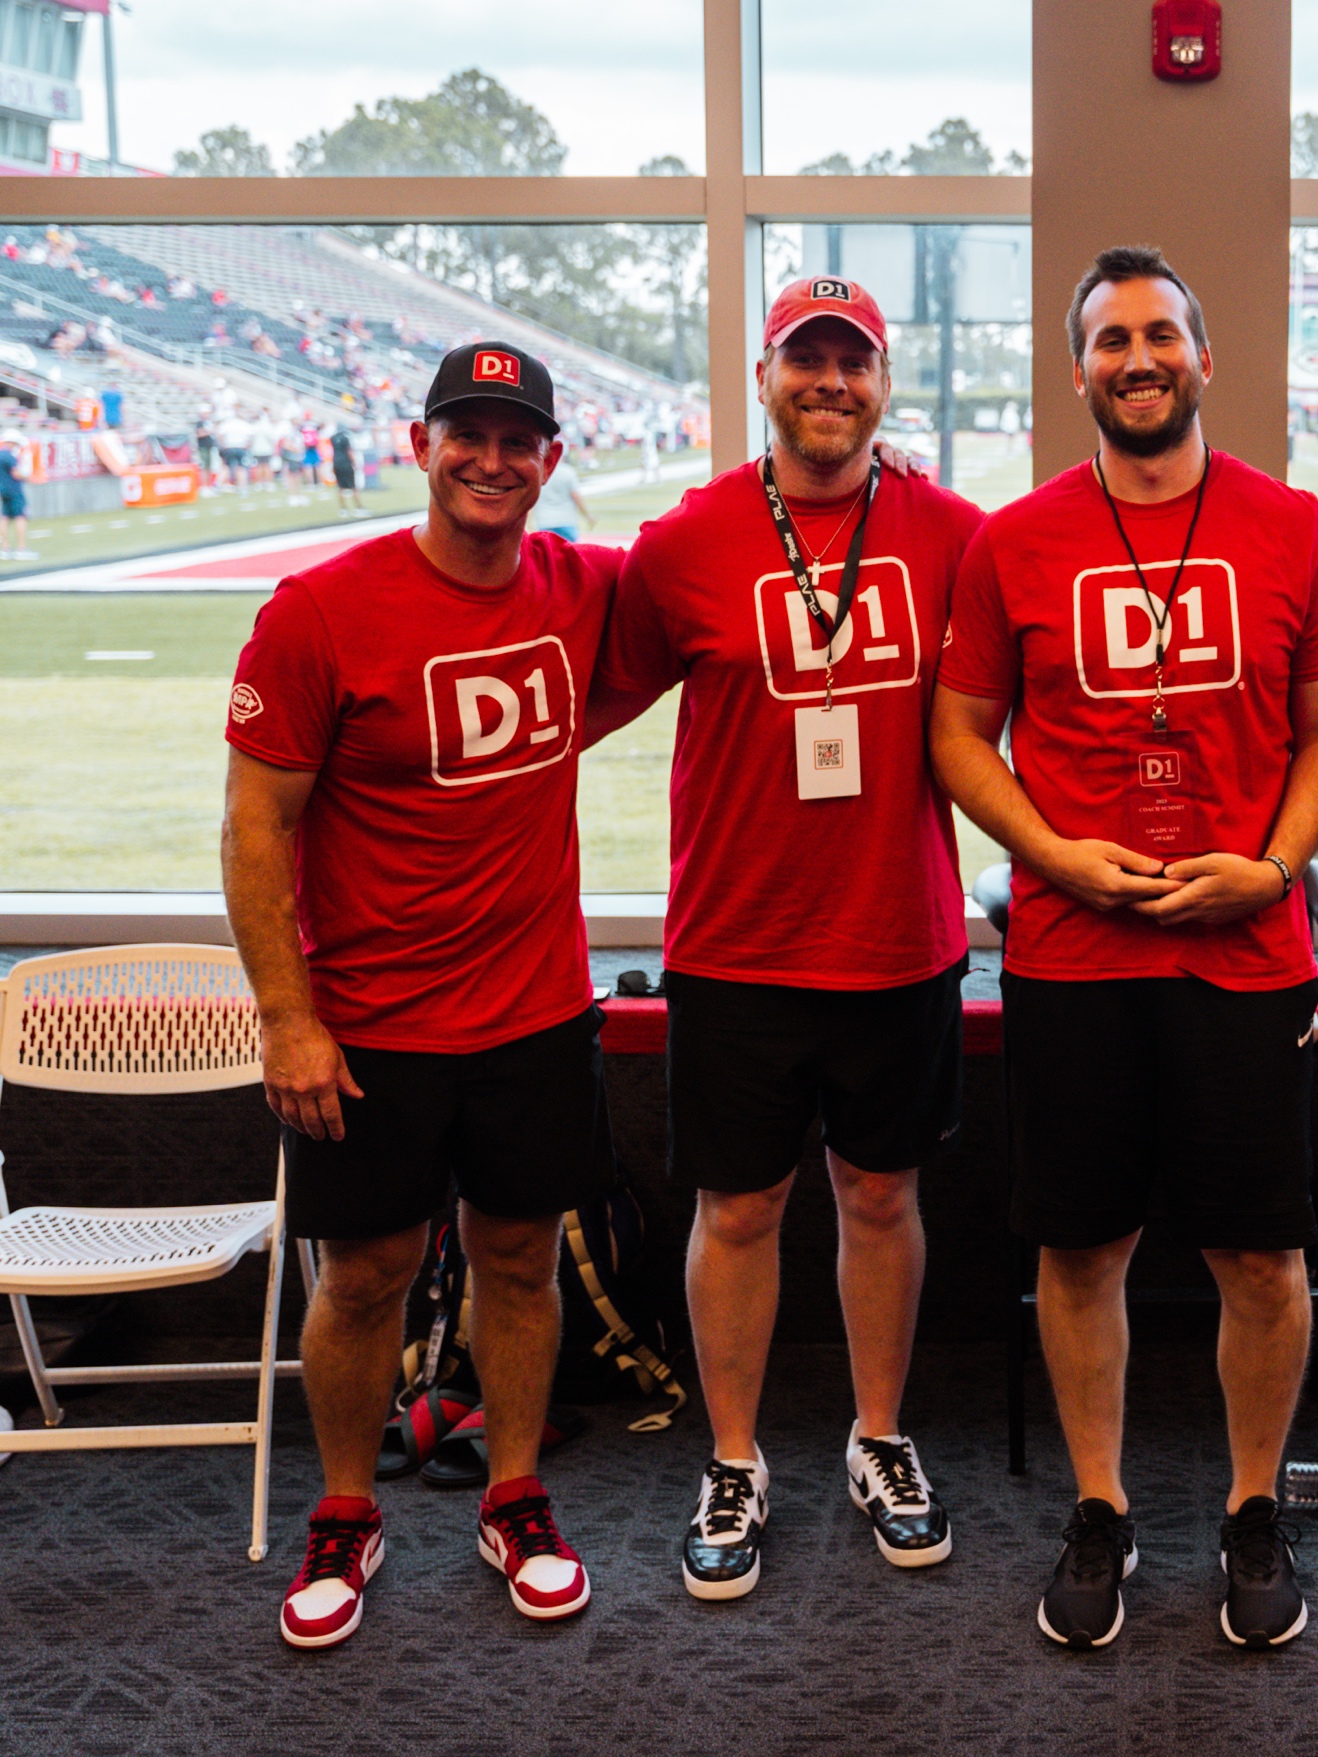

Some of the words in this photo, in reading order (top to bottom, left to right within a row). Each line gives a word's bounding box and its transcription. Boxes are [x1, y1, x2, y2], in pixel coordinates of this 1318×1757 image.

[816, 281, 845, 298] D1
[481, 355, 515, 380] D1
[765, 484, 785, 521] PLAE
[797, 573, 821, 617] PLAE
[784, 585, 900, 672] D1
[1103, 586, 1218, 668] D1
[455, 667, 560, 758] D1
[1146, 758, 1175, 780] D1
[1145, 826, 1181, 834] GRADUATE
